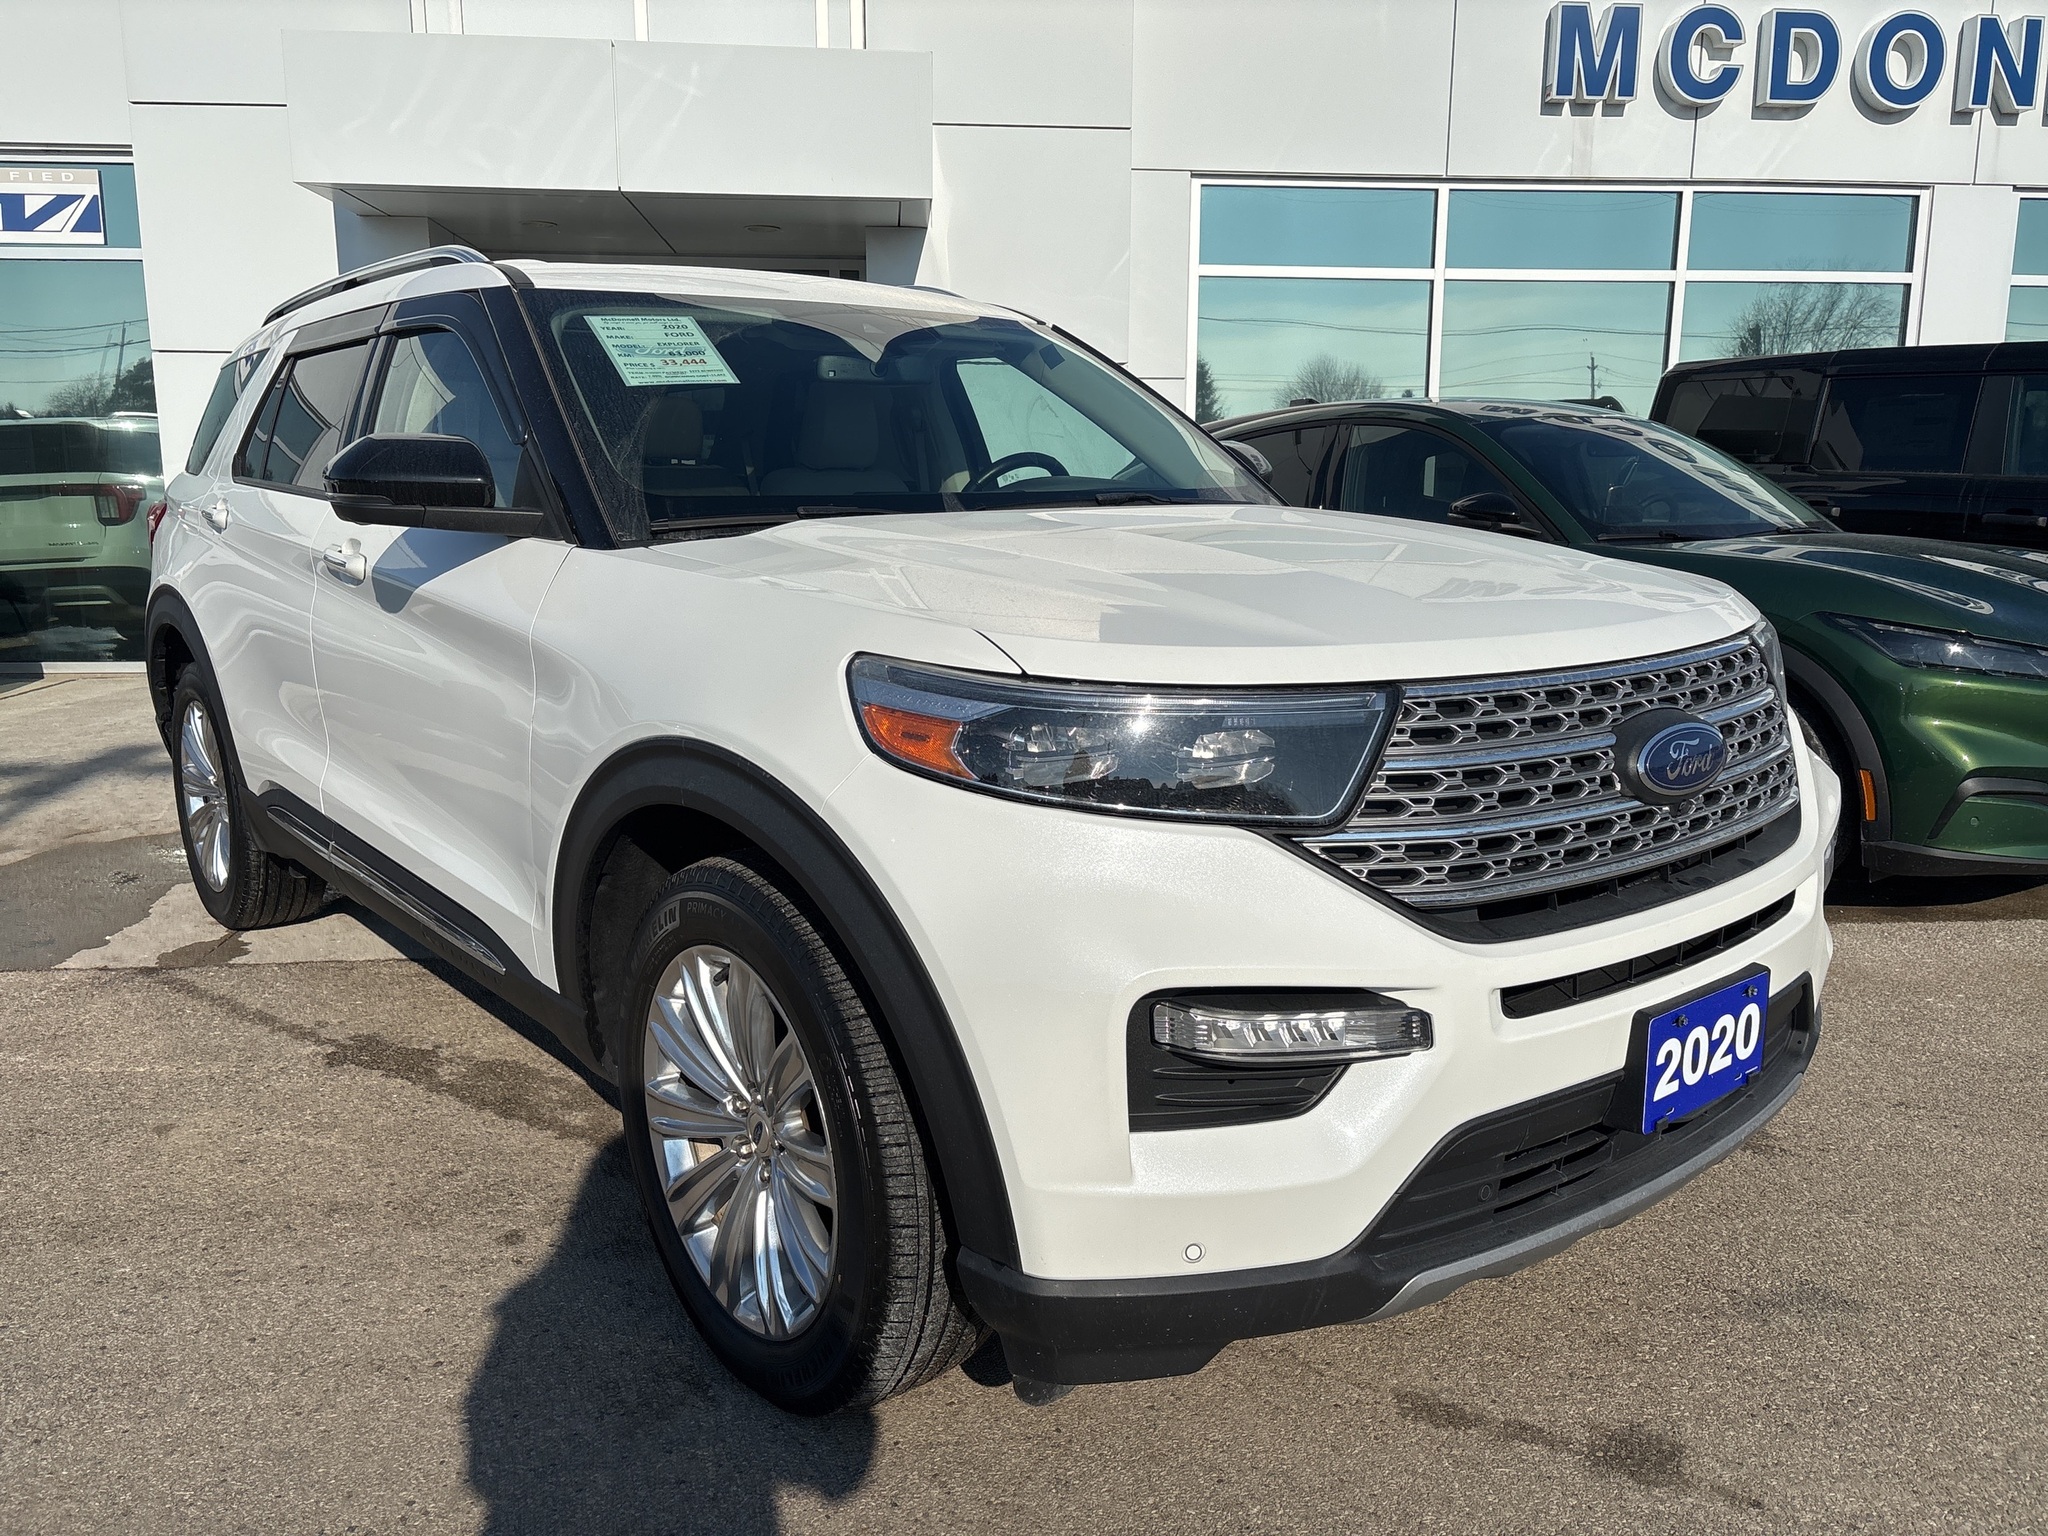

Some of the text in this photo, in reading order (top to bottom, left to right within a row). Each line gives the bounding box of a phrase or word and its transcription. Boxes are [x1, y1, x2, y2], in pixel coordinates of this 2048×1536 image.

[1548, 1, 2045, 111] MCDON
[9, 171, 75, 182] FIED
[660, 358, 707, 367] 33,444
[1666, 737, 1714, 780] Ford
[686, 901, 727, 919] PRIMACY
[1653, 1003, 1761, 1103] 2020
